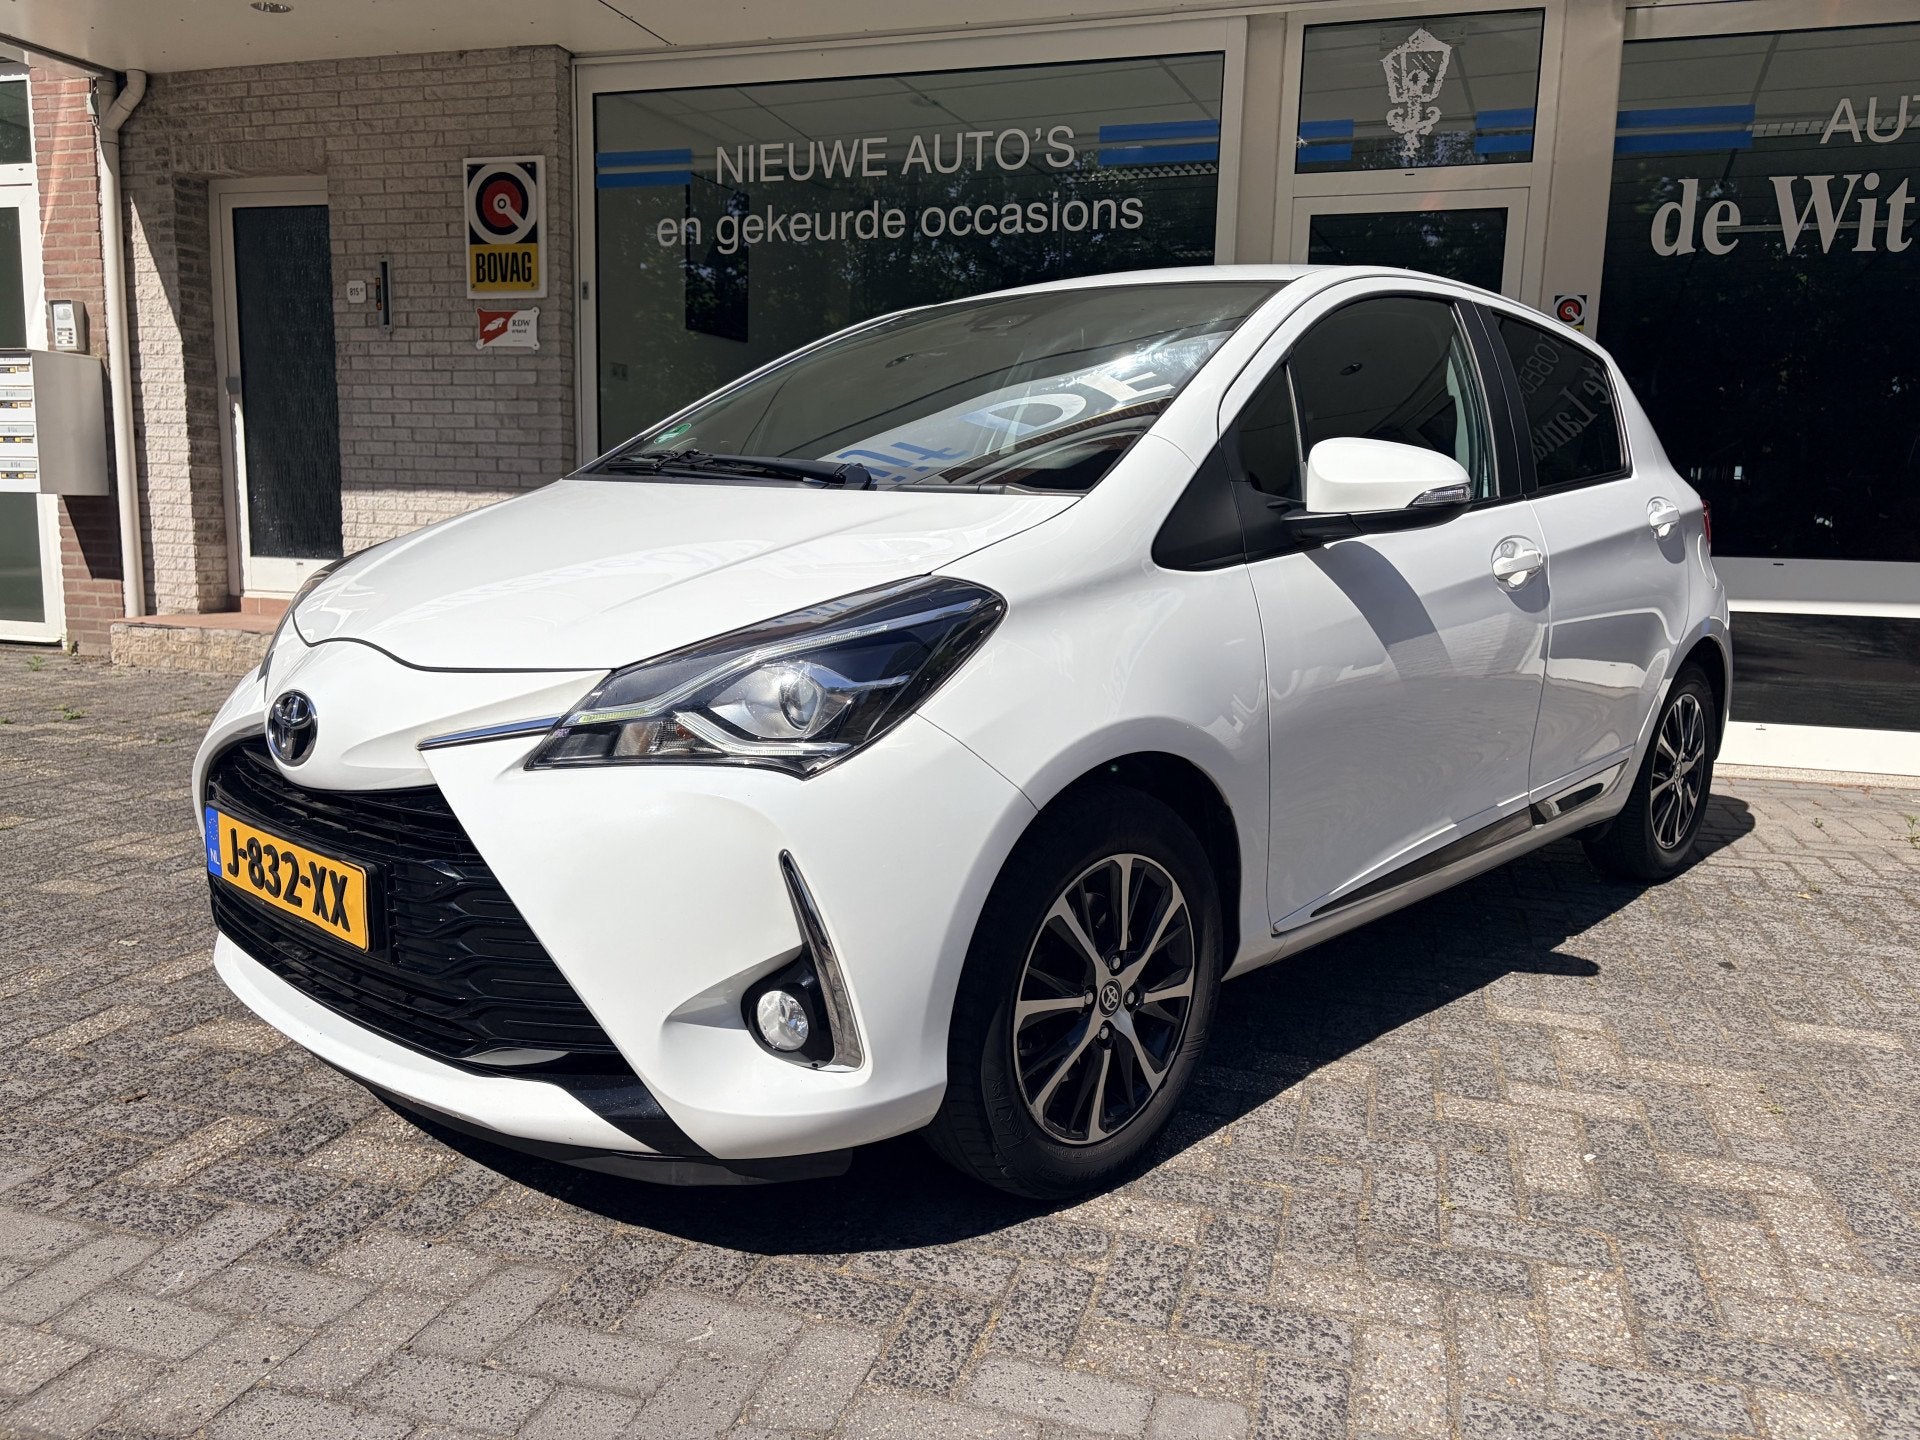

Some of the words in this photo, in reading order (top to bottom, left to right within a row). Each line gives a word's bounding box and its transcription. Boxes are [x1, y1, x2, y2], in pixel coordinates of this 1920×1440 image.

[1820, 95, 1920, 144] AU
[717, 138, 888, 183] NIEUWE
[902, 126, 1075, 175] AUTO'S
[656, 217, 701, 246] en
[716, 200, 906, 255] gekeurde
[921, 191, 1144, 237] occasions
[1651, 178, 1741, 256] de
[1769, 172, 1916, 255] Wit
[476, 252, 532, 282] BOVAG
[512, 319, 530, 327] RDW
[209, 848, 221, 866] NL
[227, 828, 351, 933] J-832-XX
